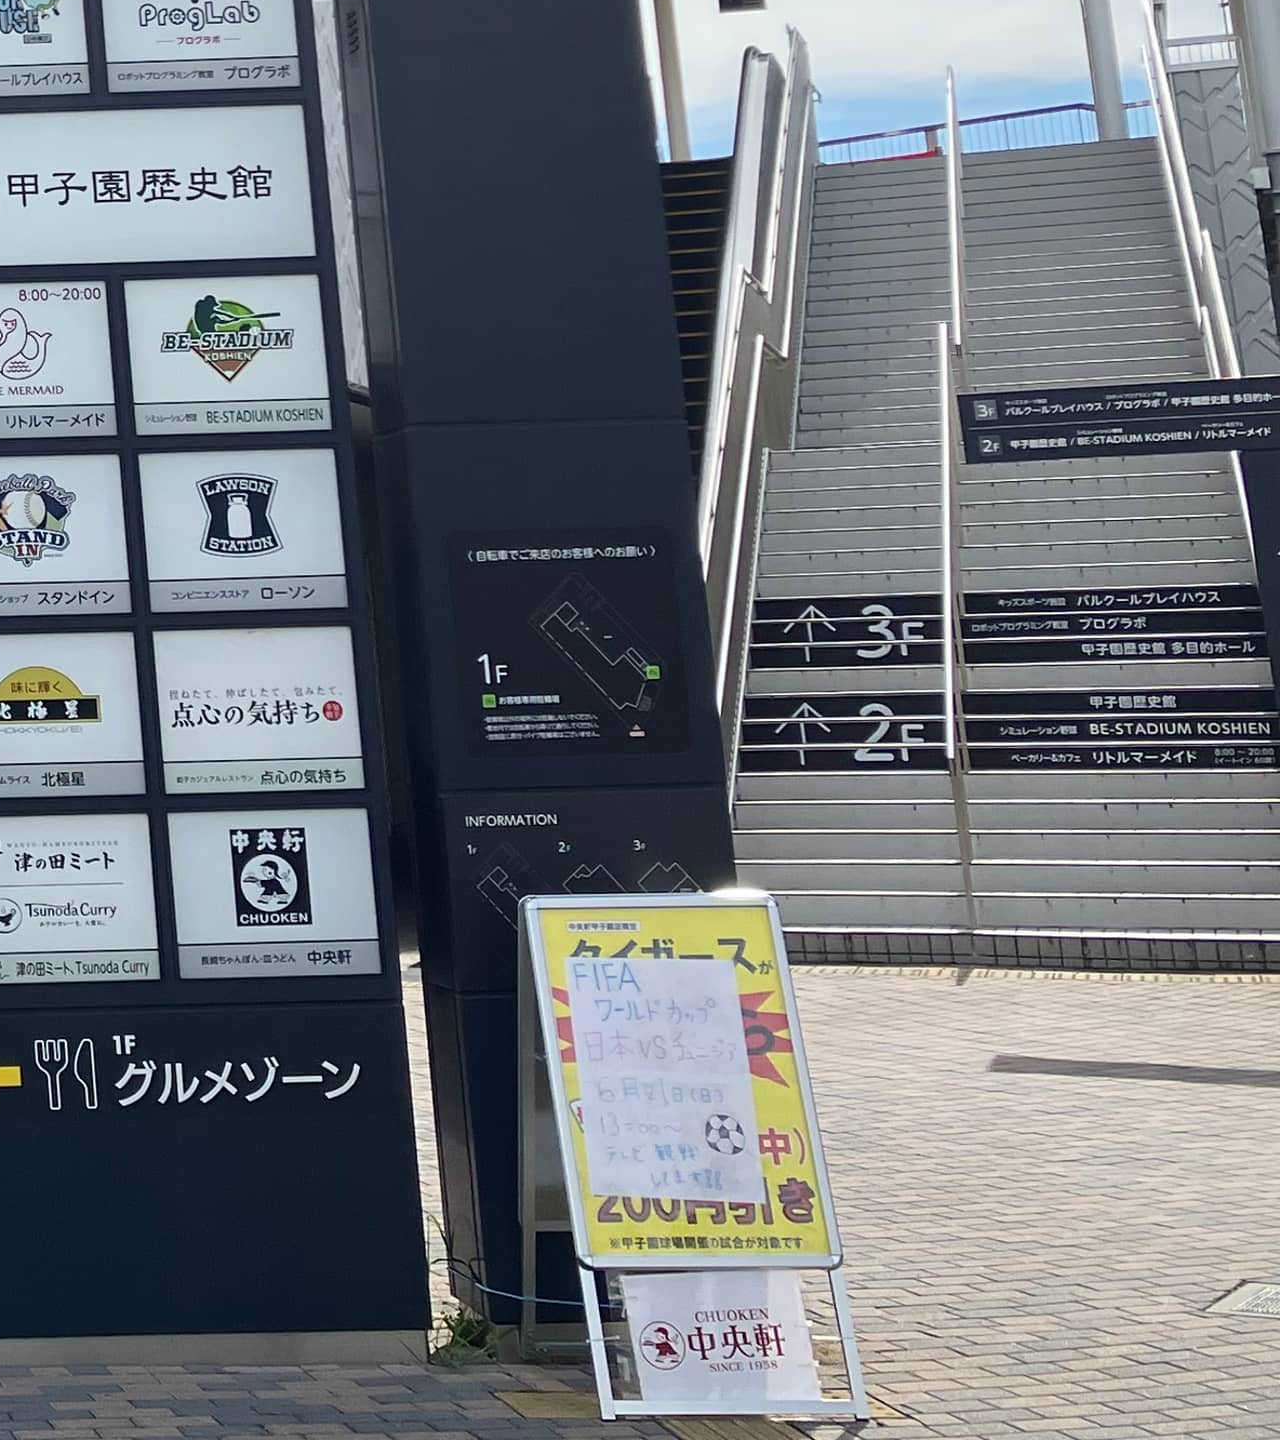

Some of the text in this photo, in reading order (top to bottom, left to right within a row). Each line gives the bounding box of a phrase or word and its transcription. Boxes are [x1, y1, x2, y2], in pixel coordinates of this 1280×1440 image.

[139, 1, 261, 31] ProgLab
[224, 64, 291, 80] プログラボ
[7, 164, 273, 208] 甲子園歴史館
[161, 330, 293, 351] BE-STADIUM
[204, 351, 252, 362] KOSHIEN
[7, 385, 65, 397] MERMAID
[207, 408, 324, 424] BE-STADIUM KOSHIEN
[978, 404, 995, 417] 3F
[1005, 402, 1103, 416] パルクールプレイハウス
[1114, 399, 1160, 410] プログラボ
[6, 413, 106, 430] リトルマーメイド
[982, 440, 999, 453] 2F
[1077, 433, 1143, 446] BE-STADIUM
[1144, 431, 1192, 442] KOSHIEN
[1202, 427, 1271, 440] リトルマーメイド
[203, 478, 271, 496] LAWSON
[16, 544, 39, 557] IN
[208, 535, 274, 553] STATION
[38, 590, 115, 606] スタンドイン
[261, 585, 315, 601] ローソン
[1077, 592, 1221, 607] パルクールプレイハウス
[856, 604, 925, 658] 3F
[1079, 616, 1147, 630] プログラボ
[1081, 642, 1256, 656] 甲子園歴史館 多目的ホール
[477, 653, 508, 684] 1F
[10, 680, 62, 694] 味に輝く
[1090, 695, 1177, 709] 甲子園歴史館
[171, 699, 320, 728] 点心の気持ち
[854, 704, 925, 762] 2F
[1090, 722, 1192, 736] BE-STADIUM
[1197, 721, 1271, 735] KOSHIEN
[1093, 750, 1198, 764] リトルマーメイド
[41, 771, 85, 787] 北極星
[260, 769, 346, 785] 点心の気持ち
[465, 814, 558, 827] INFORMATION
[231, 829, 304, 854] 中央軒
[14, 851, 115, 872] 津の田ミート
[25, 901, 117, 918] Tsunoda Curry
[240, 913, 308, 924] CHUOKEN
[307, 949, 352, 965] 中央軒
[122, 960, 149, 975] Curry
[572, 961, 642, 994] FIFA
[112, 1035, 136, 1055] 1F
[114, 1056, 361, 1107] グルメゾーン
[695, 1308, 770, 1323] CHUOKEN
[687, 1323, 786, 1361] 中央軒
[710, 1360, 778, 1373] SINCE 1958
